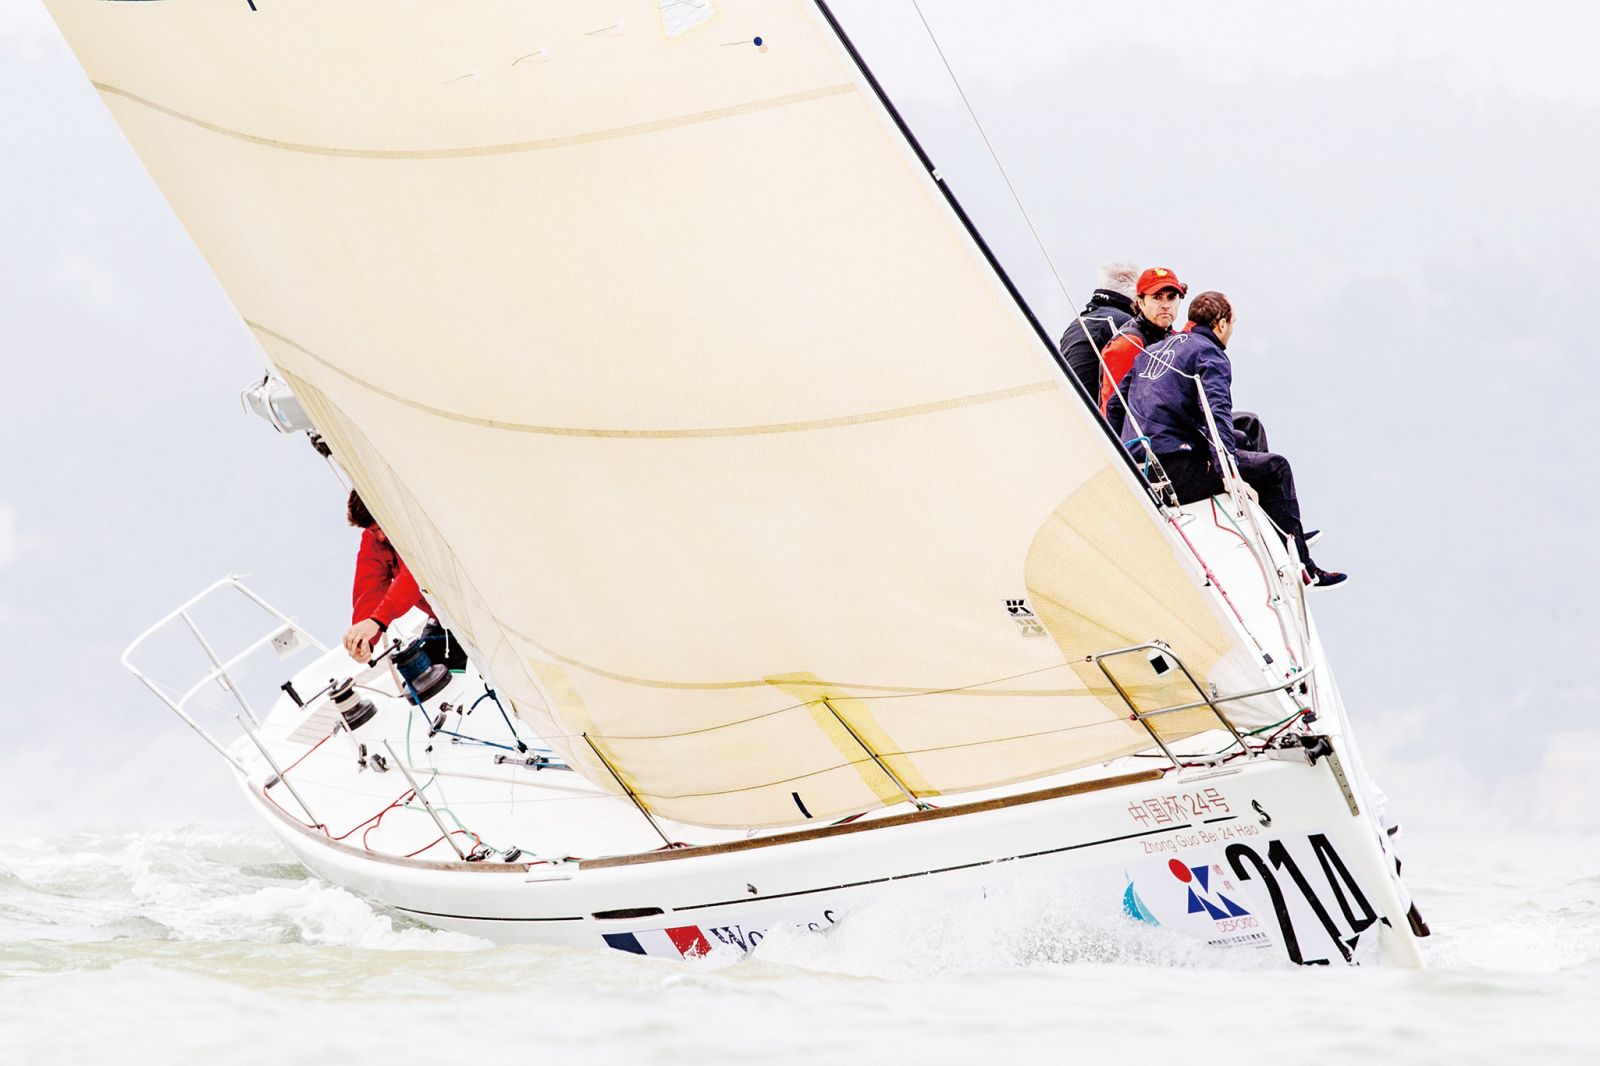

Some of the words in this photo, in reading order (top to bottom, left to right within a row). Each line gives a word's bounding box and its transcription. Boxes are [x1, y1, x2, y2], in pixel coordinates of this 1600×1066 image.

[1128, 788, 1230, 827] 中国杯24号
[1140, 838, 1178, 853] Zhong
[1175, 834, 1200, 848] Guo
[1218, 827, 1234, 840] 24
[1234, 824, 1259, 836] Hao
[1225, 833, 1392, 966] 214
